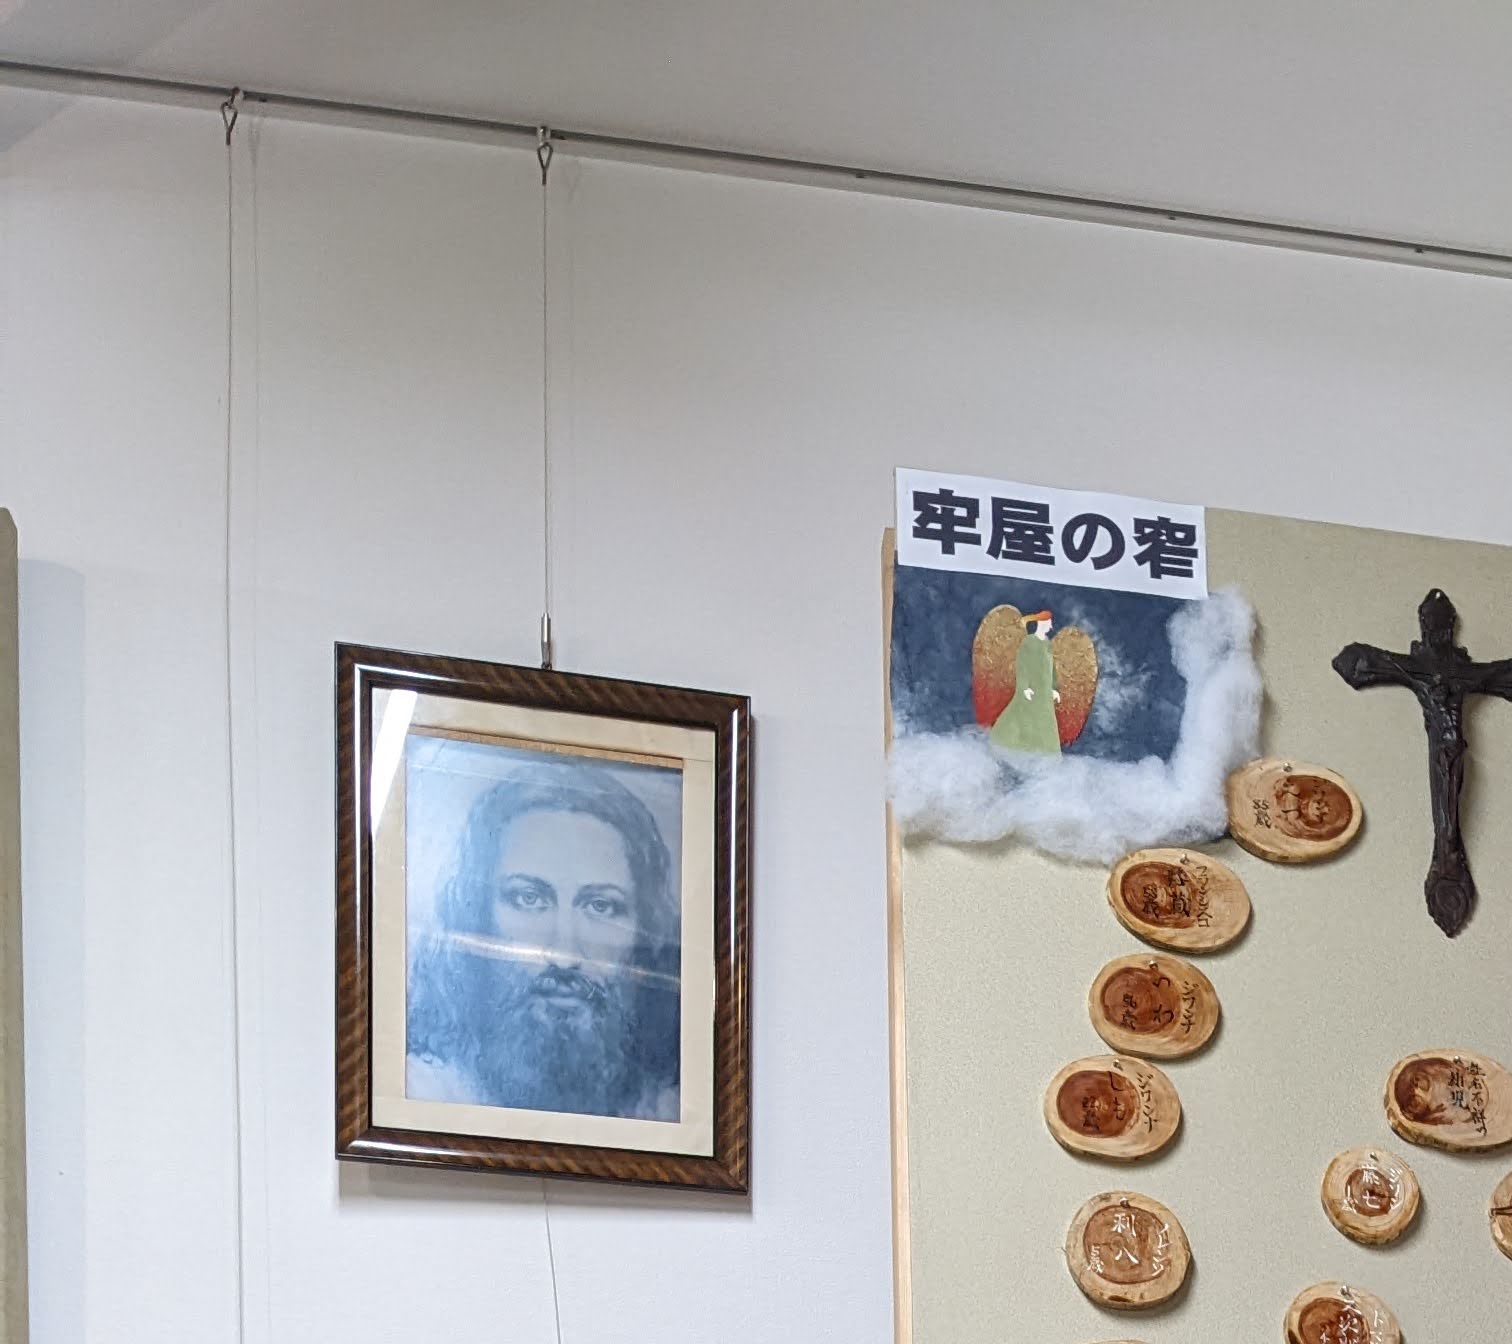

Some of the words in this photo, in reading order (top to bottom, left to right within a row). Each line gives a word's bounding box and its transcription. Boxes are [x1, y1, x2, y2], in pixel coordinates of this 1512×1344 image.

[912, 487, 1198, 579] 牢屋の窄
[1112, 1212, 1138, 1264] 利八
